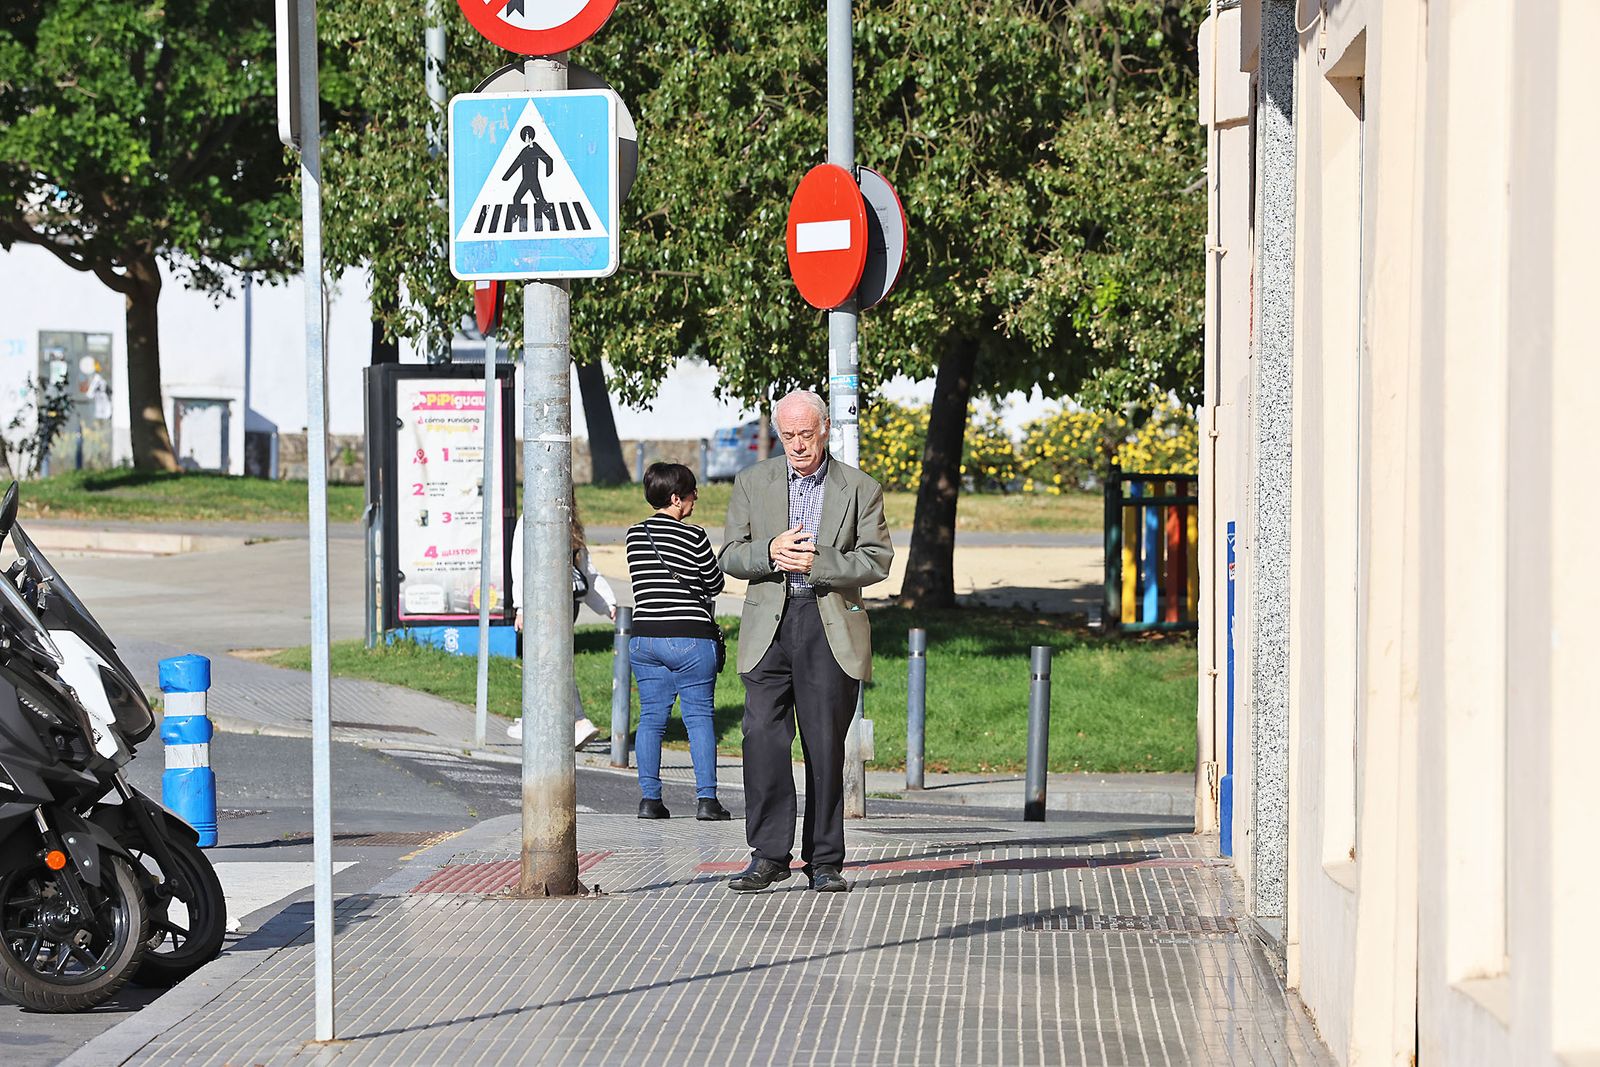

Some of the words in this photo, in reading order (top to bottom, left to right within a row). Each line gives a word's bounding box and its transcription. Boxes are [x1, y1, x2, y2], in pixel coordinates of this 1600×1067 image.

[442, 447, 449, 461] 1
[412, 483, 425, 496] 2
[442, 511, 452, 523] 3
[424, 545, 438, 558] 4
